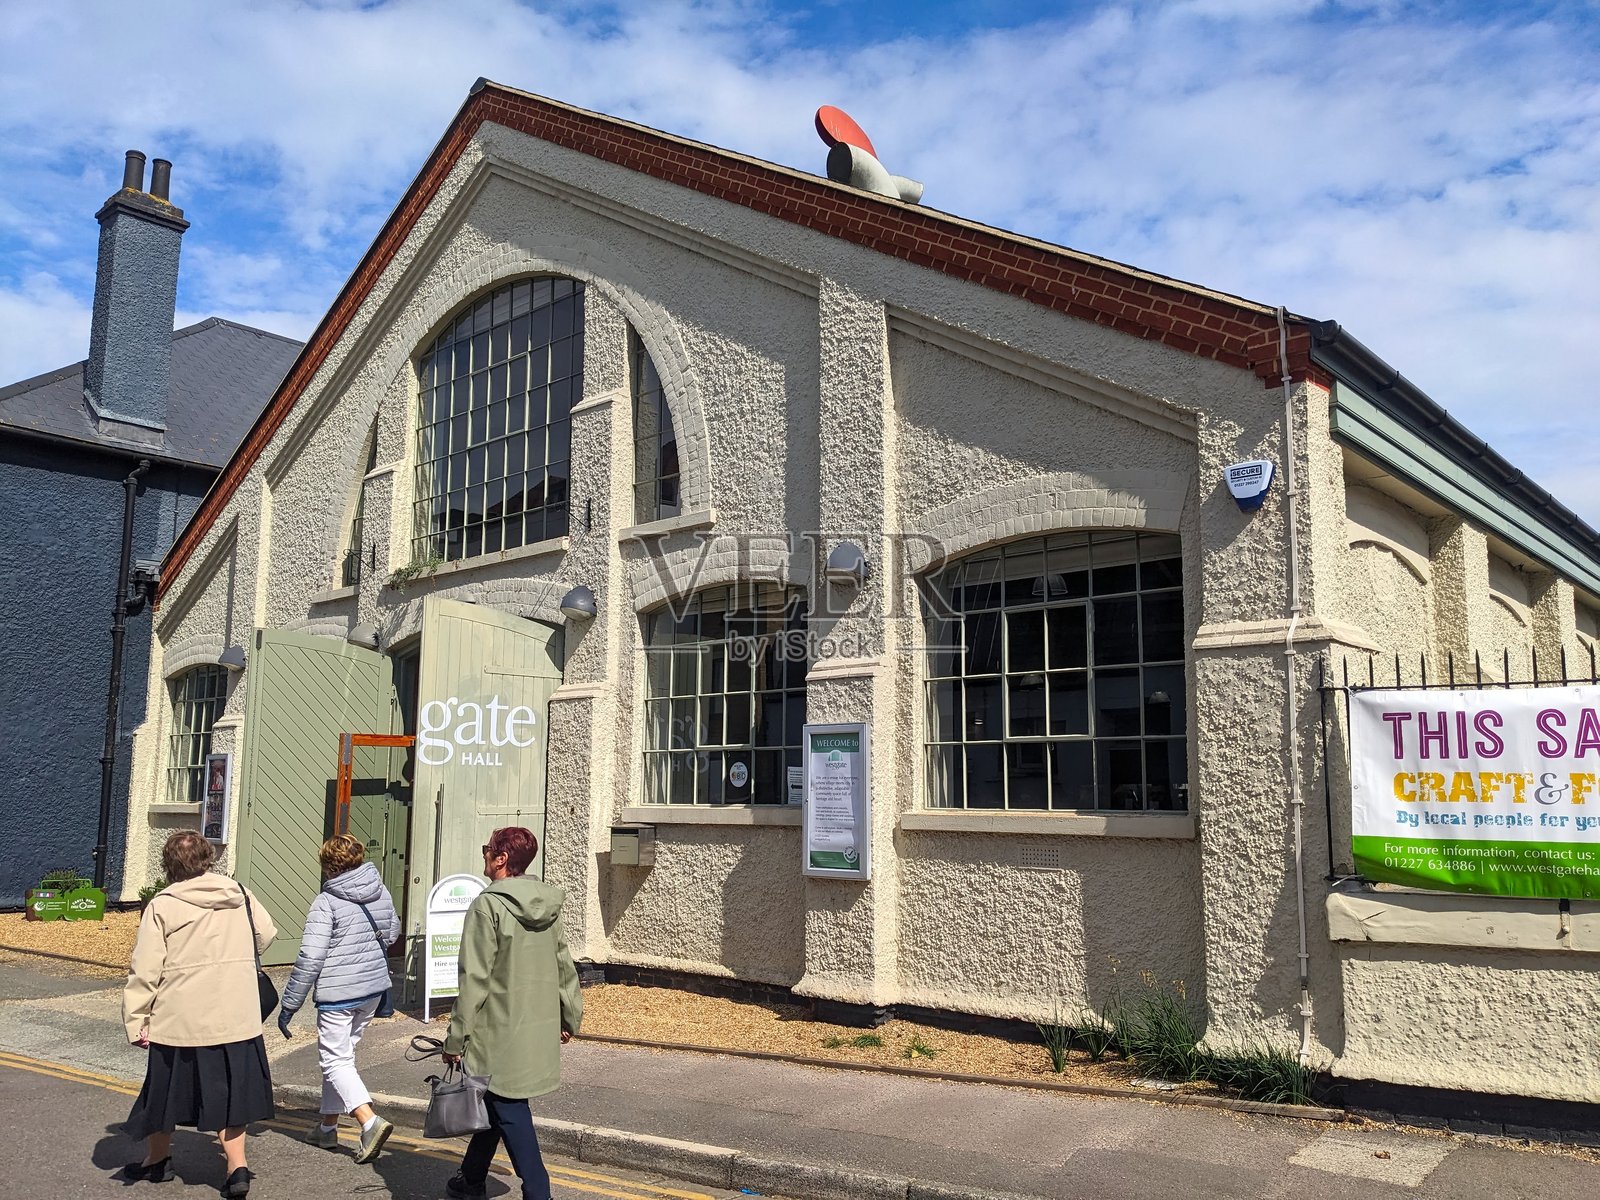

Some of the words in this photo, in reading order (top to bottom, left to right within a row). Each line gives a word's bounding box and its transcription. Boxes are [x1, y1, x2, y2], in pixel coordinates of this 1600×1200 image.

[1232, 468, 1260, 476] SECURE
[417, 695, 536, 765] gate
[1383, 710, 1504, 760] THIS
[852, 739, 858, 747] to
[461, 752, 503, 766] HALL
[1394, 772, 1534, 803] CRAFT
[1534, 772, 1570, 805] &
[1569, 772, 1600, 804] F
[1396, 810, 1419, 828] By
[1424, 811, 1467, 825] local
[1474, 812, 1534, 828] people
[1540, 812, 1569, 827] for
[1575, 816, 1600, 831] yo
[1384, 842, 1404, 853] For
[1407, 846, 1439, 855] more
[1442, 844, 1520, 860] information,
[1524, 849, 1572, 860] contact
[1577, 851, 1596, 860] us:
[1384, 856, 1424, 868] 01227
[1428, 859, 1476, 871] 634886
